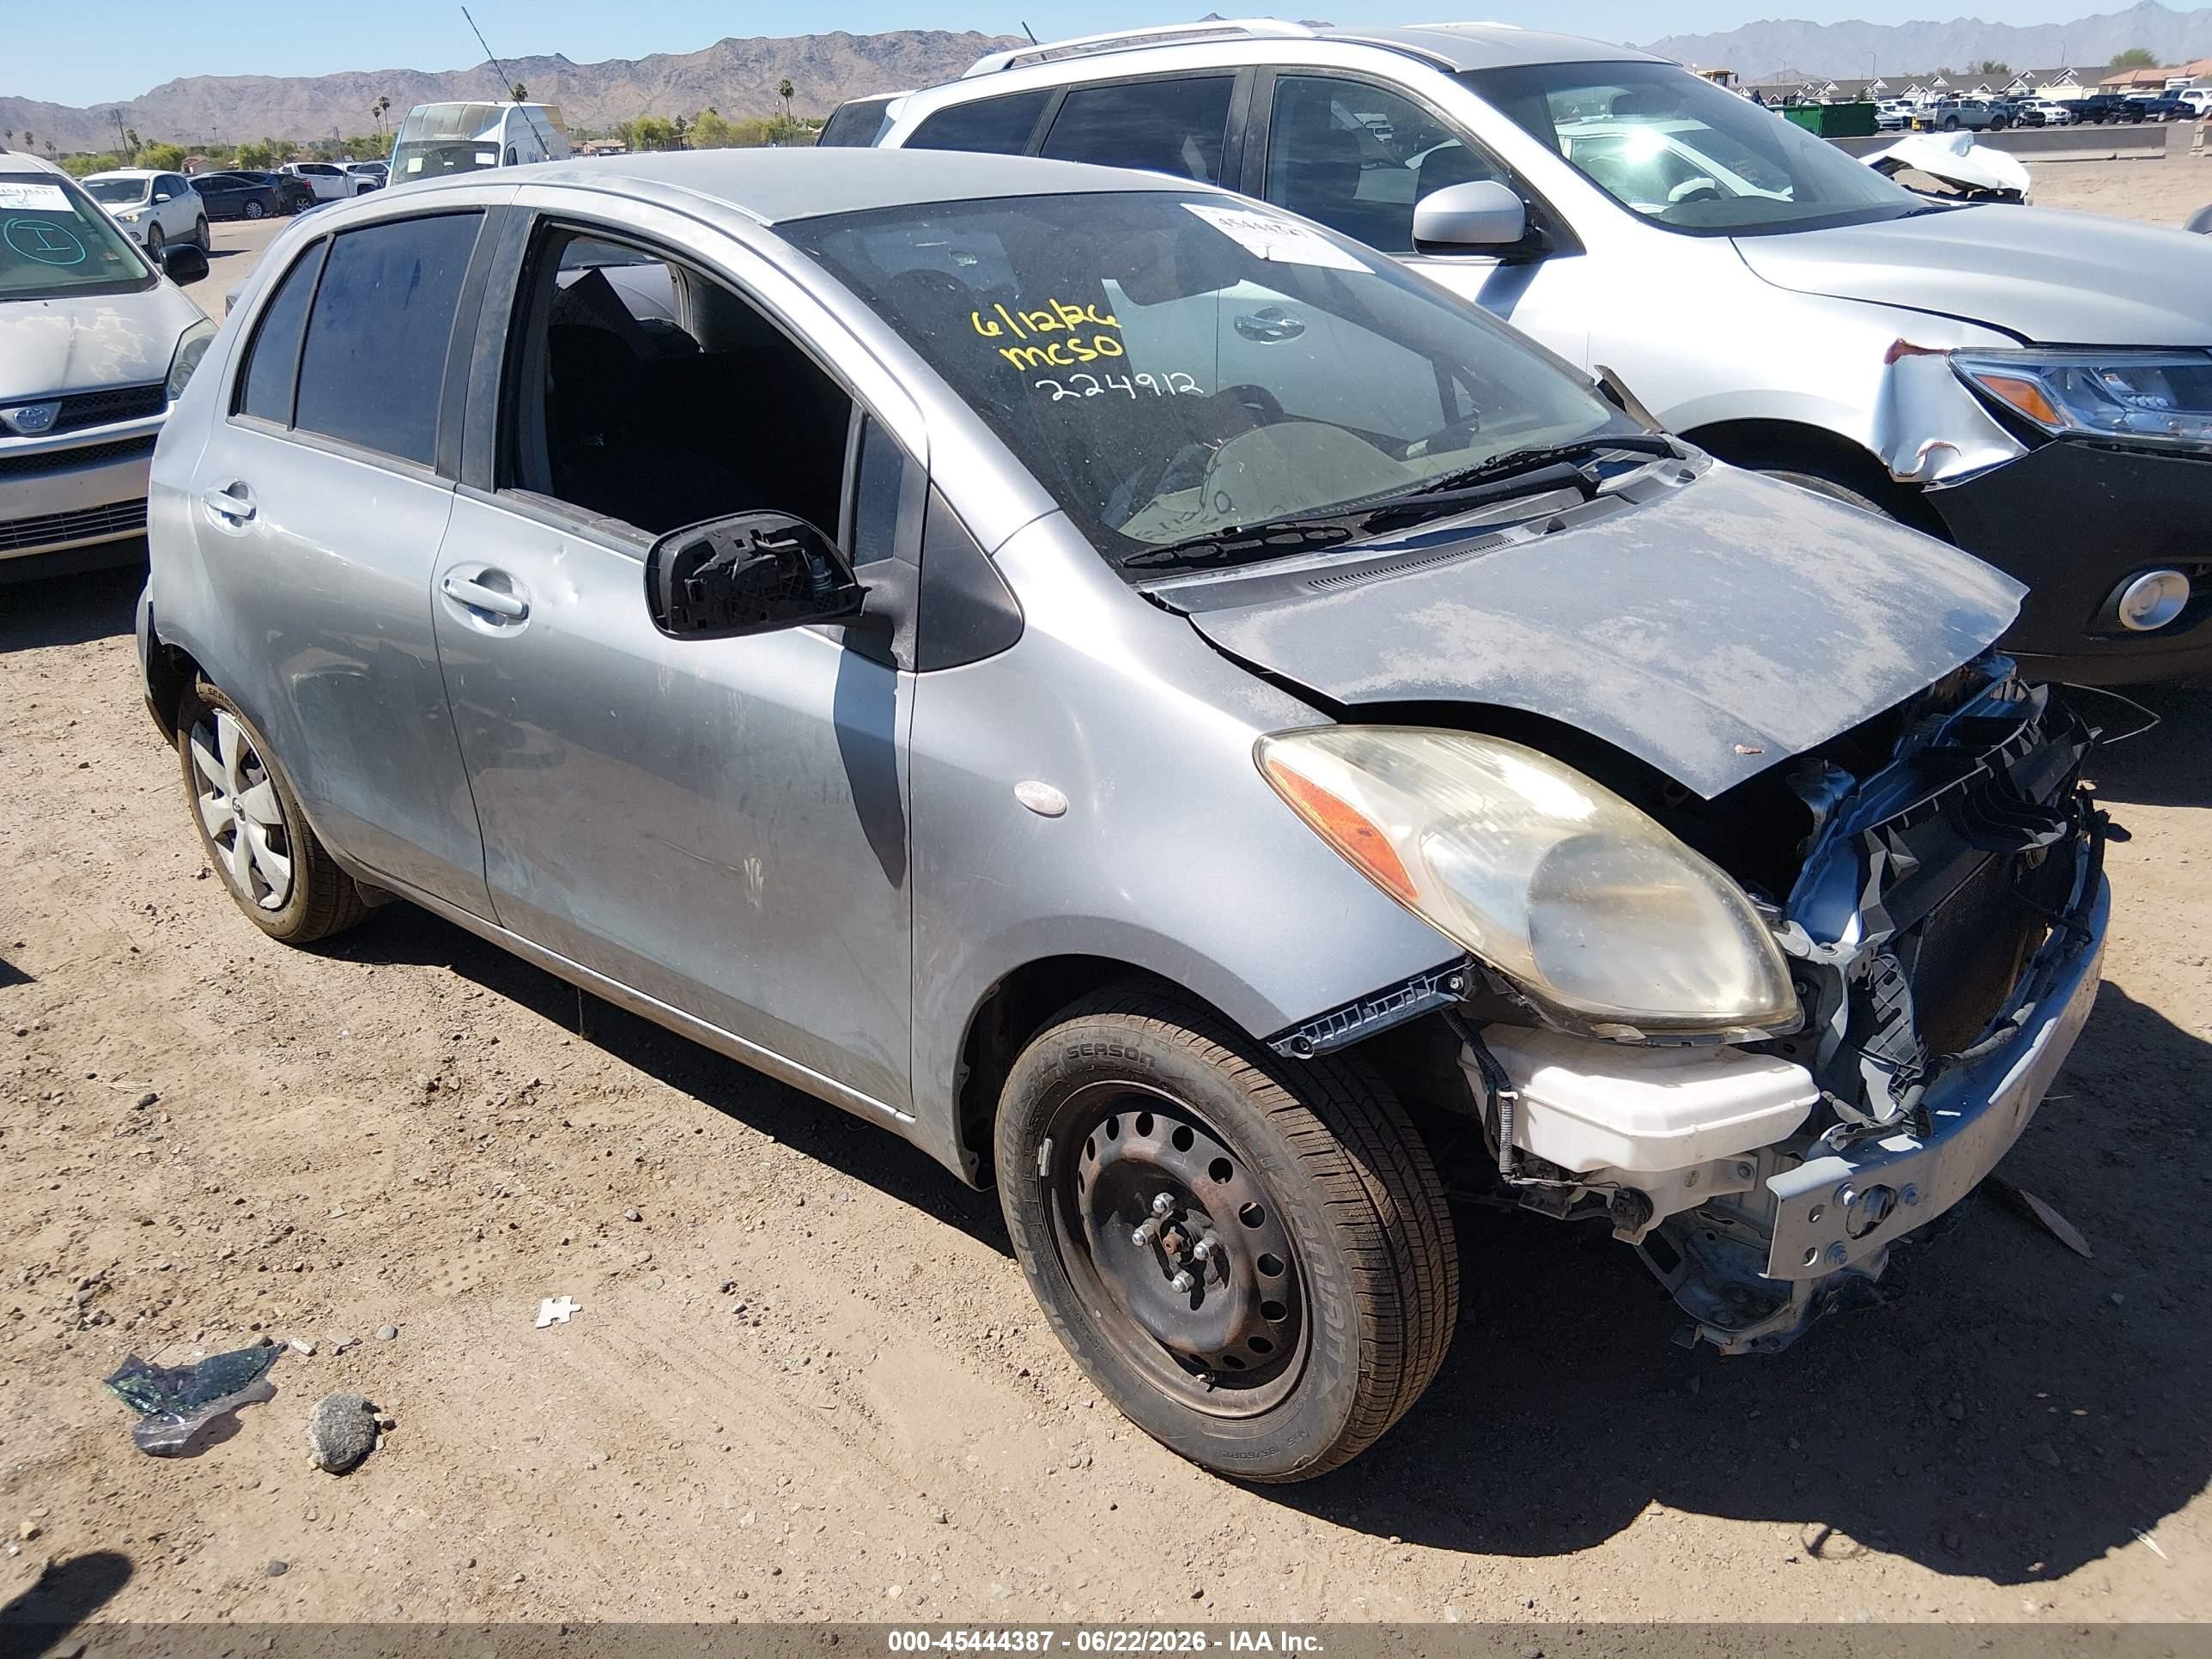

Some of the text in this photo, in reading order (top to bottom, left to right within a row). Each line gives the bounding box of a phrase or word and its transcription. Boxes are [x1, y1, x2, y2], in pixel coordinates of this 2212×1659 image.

[970, 298, 1122, 339] 6/12/26
[1035, 371, 1204, 401] 224912
[208, 687, 242, 720] SEASON
[1066, 1042, 1156, 1068] SEASON
